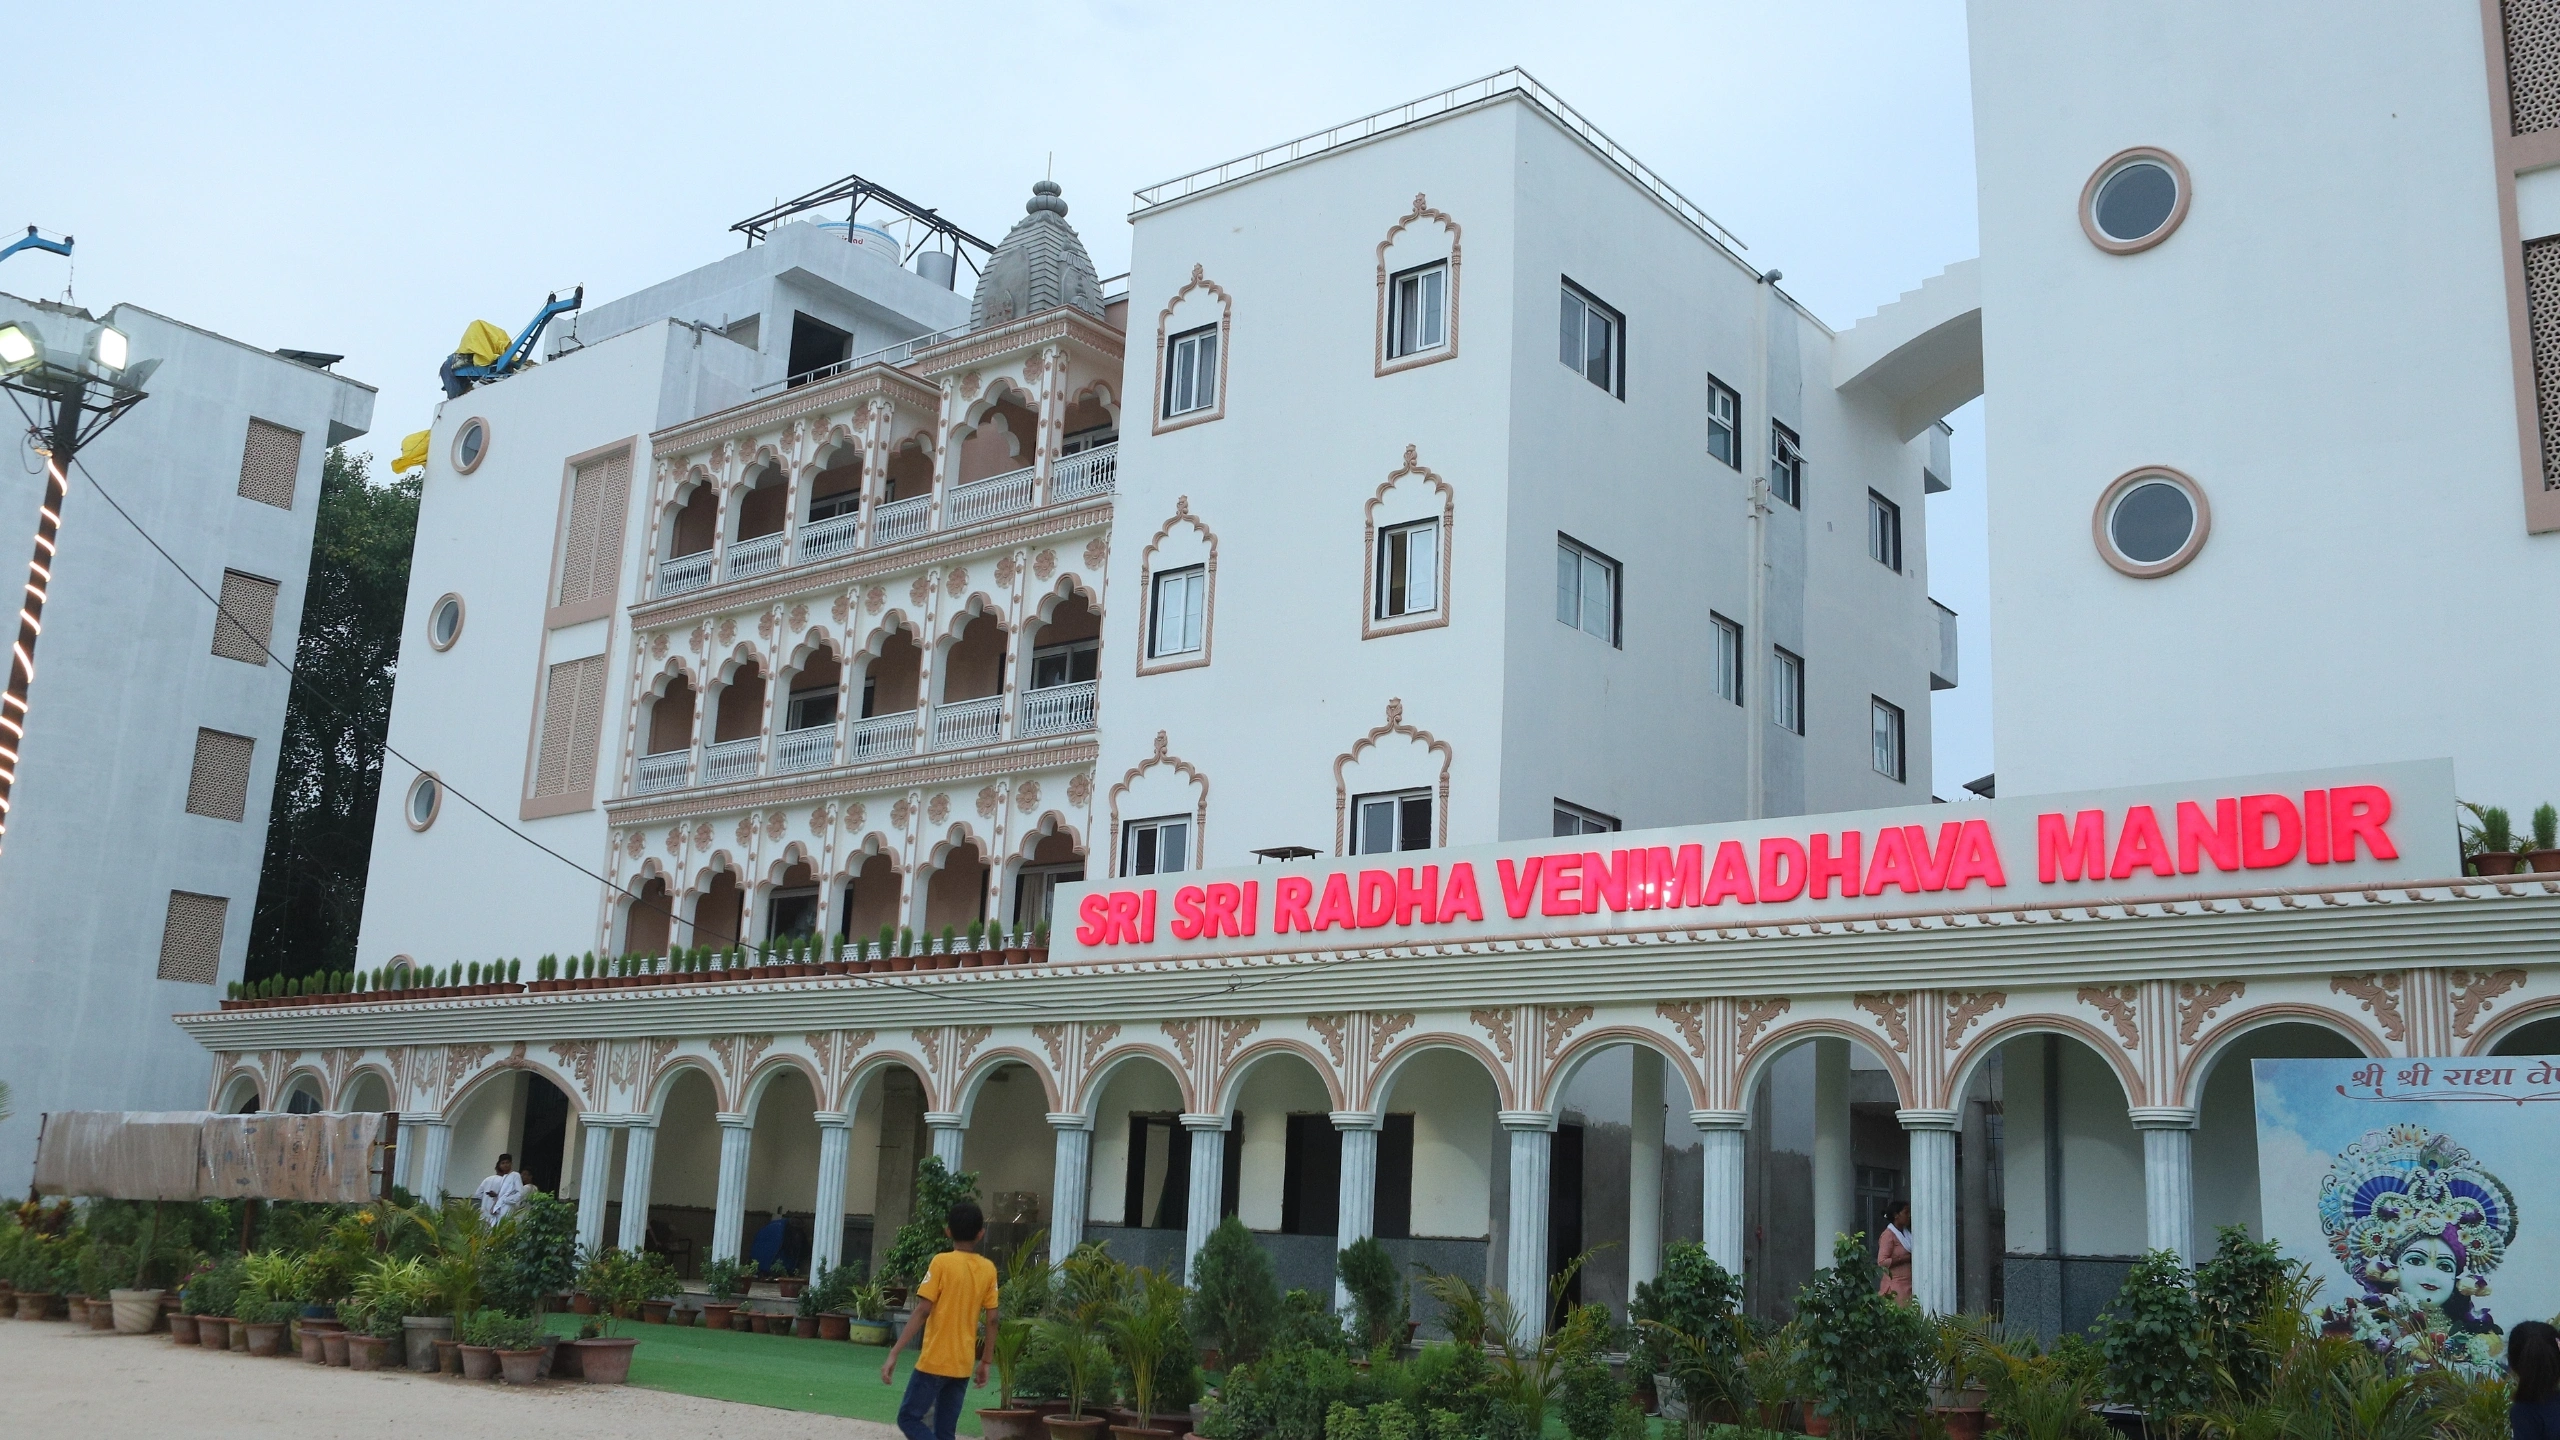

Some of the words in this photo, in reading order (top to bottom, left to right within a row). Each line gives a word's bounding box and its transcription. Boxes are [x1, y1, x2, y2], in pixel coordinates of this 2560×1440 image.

[1075, 888, 1158, 947] SRI
[1170, 879, 1260, 941] SRI
[1273, 861, 1484, 934] RADHA
[1495, 818, 2007, 920] VENIMADHAVA
[2036, 784, 2399, 883] MANDIR
[2352, 1063, 2386, 1087] श्री
[2397, 1062, 2433, 1087] श्री
[2443, 1068, 2516, 1086] राधा
